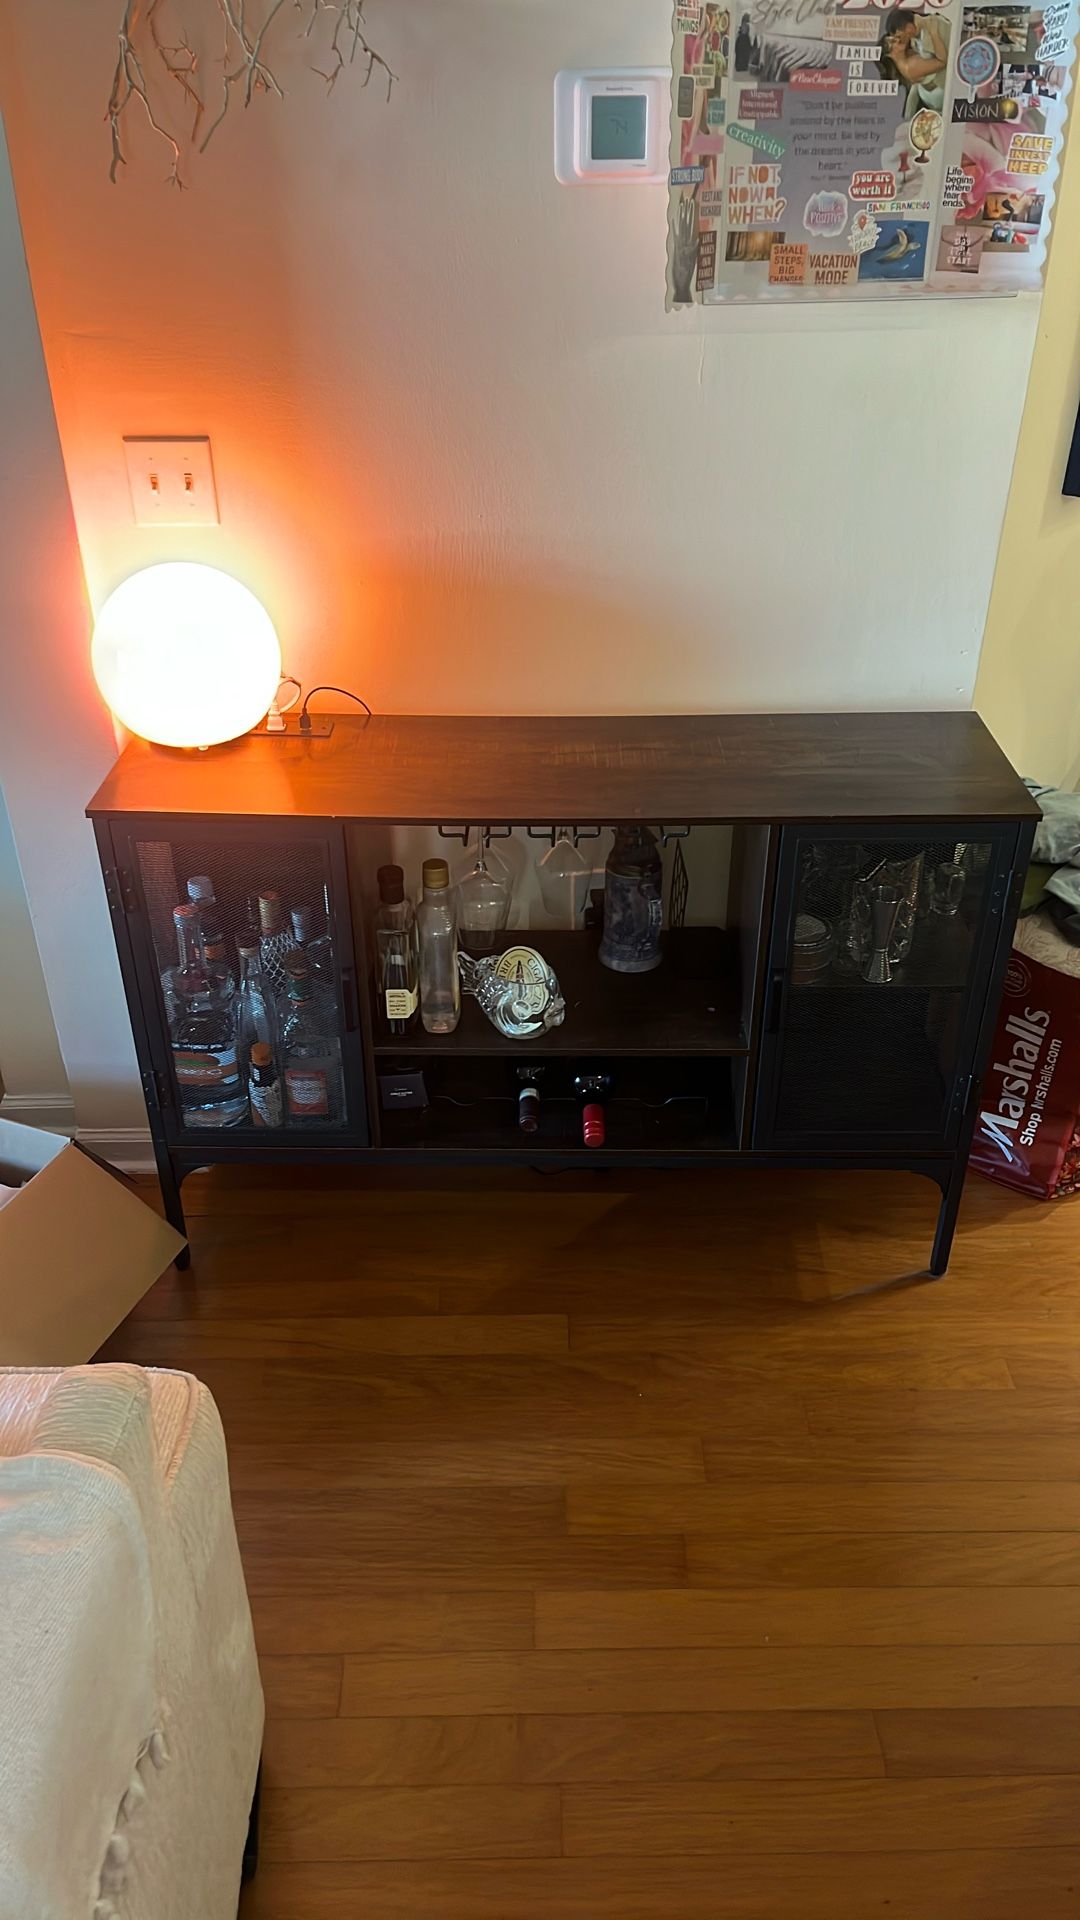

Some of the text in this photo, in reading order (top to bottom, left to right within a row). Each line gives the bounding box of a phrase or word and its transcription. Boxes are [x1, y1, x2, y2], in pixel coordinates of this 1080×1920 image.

[840, 47, 881, 59] FAMILY
[850, 66, 862, 76] IS
[849, 81, 897, 95] FOREVER
[954, 102, 999, 119] VISION
[836, 117, 851, 126] the
[729, 126, 785, 160] creativity
[1012, 134, 1053, 150] SAVE
[794, 147, 809, 156] the
[1011, 150, 1051, 160] INVEST
[947, 166, 963, 175] Life
[1008, 160, 1047, 175] KEEP
[729, 165, 745, 184] IF
[855, 174, 873, 183] you
[874, 173, 891, 183] are
[946, 175, 974, 185] begins
[852, 184, 892, 196] worth it
[945, 184, 971, 192] where
[728, 199, 785, 224] WHEN?
[867, 201, 930, 213] SAN FRANCISCO
[774, 245, 805, 255] SMALL
[809, 254, 858, 269] VACATION
[779, 266, 795, 275] BIG
[814, 270, 849, 285] MODE
[980, 1006, 1050, 1162] Marshalls
[1020, 1112, 1043, 1146] Shop
